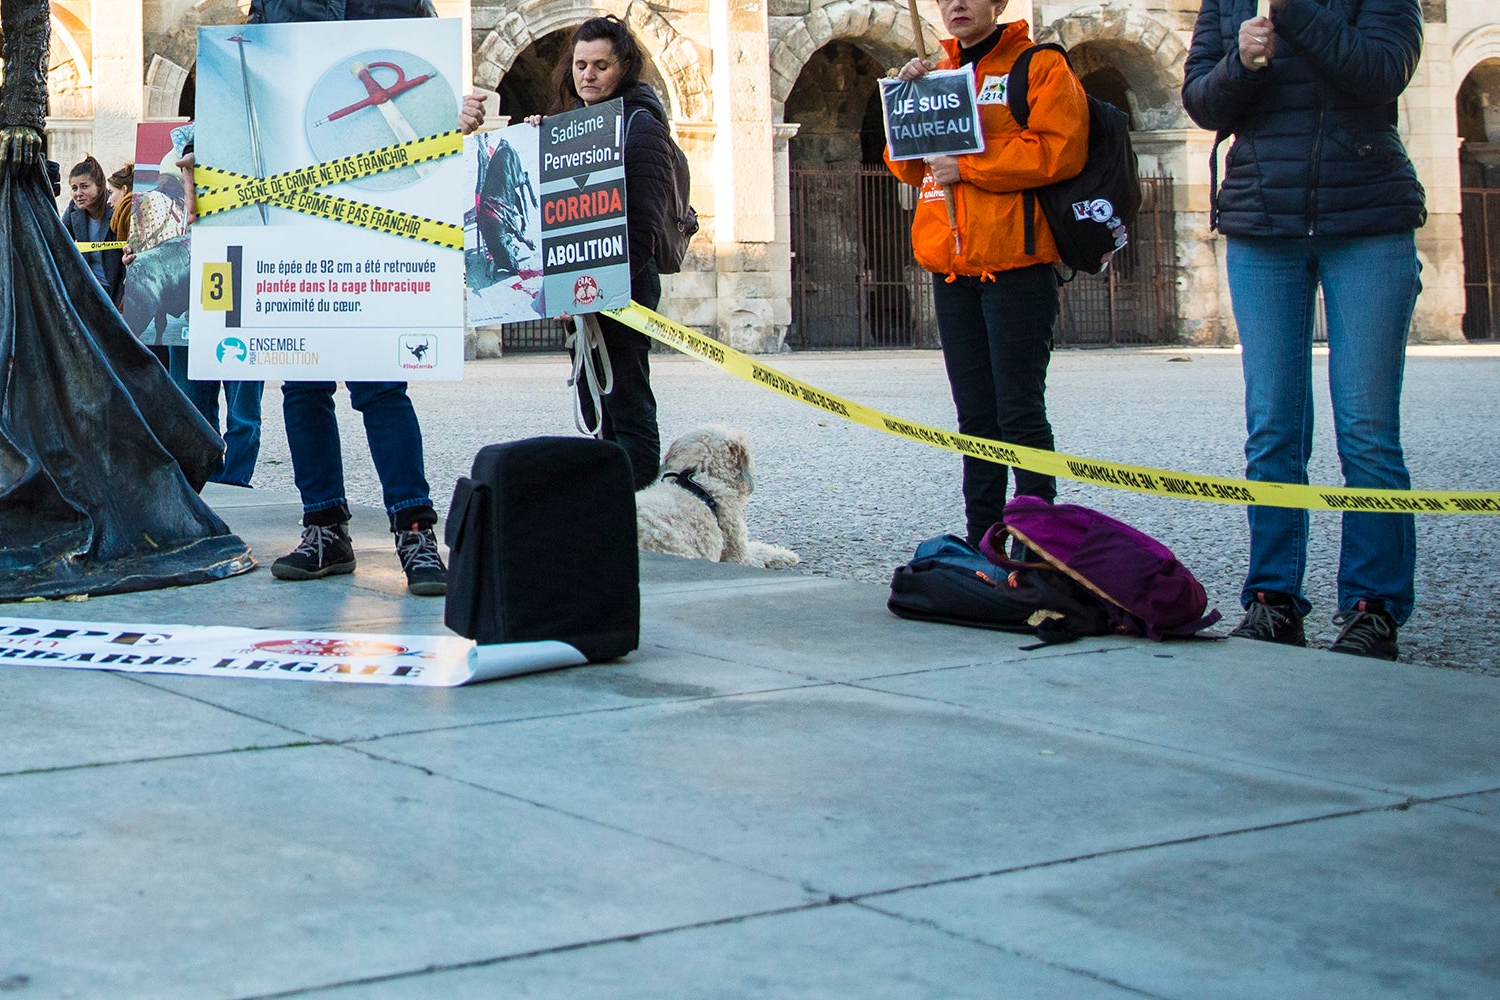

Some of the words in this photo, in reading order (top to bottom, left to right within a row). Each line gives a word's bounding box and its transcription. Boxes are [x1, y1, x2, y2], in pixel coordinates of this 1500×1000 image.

[893, 101, 914, 115] JE
[918, 93, 961, 112] SUIS
[551, 114, 604, 146] Sadisme
[891, 117, 971, 140] TAUREAU
[544, 147, 612, 171] Perversion
[237, 184, 270, 201] SCENE
[271, 179, 285, 194] DE
[286, 172, 319, 191] CRIME
[320, 167, 334, 183] NE
[335, 161, 357, 179] PAS
[357, 149, 408, 174] FRANCHIR
[298, 194, 330, 215] CRIME
[332, 203, 346, 217] NE
[347, 206, 369, 223] PAS
[370, 212, 421, 235] FRANCHIR
[544, 187, 622, 225] CORRIDA
[546, 234, 623, 267] ABOLITION
[256, 259, 276, 274] Une
[278, 260, 303, 278] épée
[305, 259, 318, 274] de
[320, 260, 334, 274] 92
[337, 262, 353, 274] cm
[355, 262, 362, 274] a
[365, 259, 381, 274] été
[383, 259, 436, 274] retrouvée
[209, 272, 224, 300] 3
[256, 279, 297, 296] plantée
[299, 280, 326, 293] dans
[328, 280, 339, 293] la
[341, 281, 367, 297] cage
[369, 278, 431, 296] thoracique
[256, 299, 262, 313] à
[264, 298, 315, 316] proximité
[317, 298, 330, 312] du
[249, 337, 306, 351] ENSEMBLE
[256, 351, 319, 365] L'ABOLITION
[1066, 459, 1118, 484] FRANCHIR
[1117, 469, 1137, 488] PAS
[1137, 474, 1155, 490] NE
[1159, 476, 1195, 496] CRIME
[1194, 482, 1212, 498] DE
[1212, 483, 1256, 502] SCENE
[212, 657, 425, 678] LEGALE
